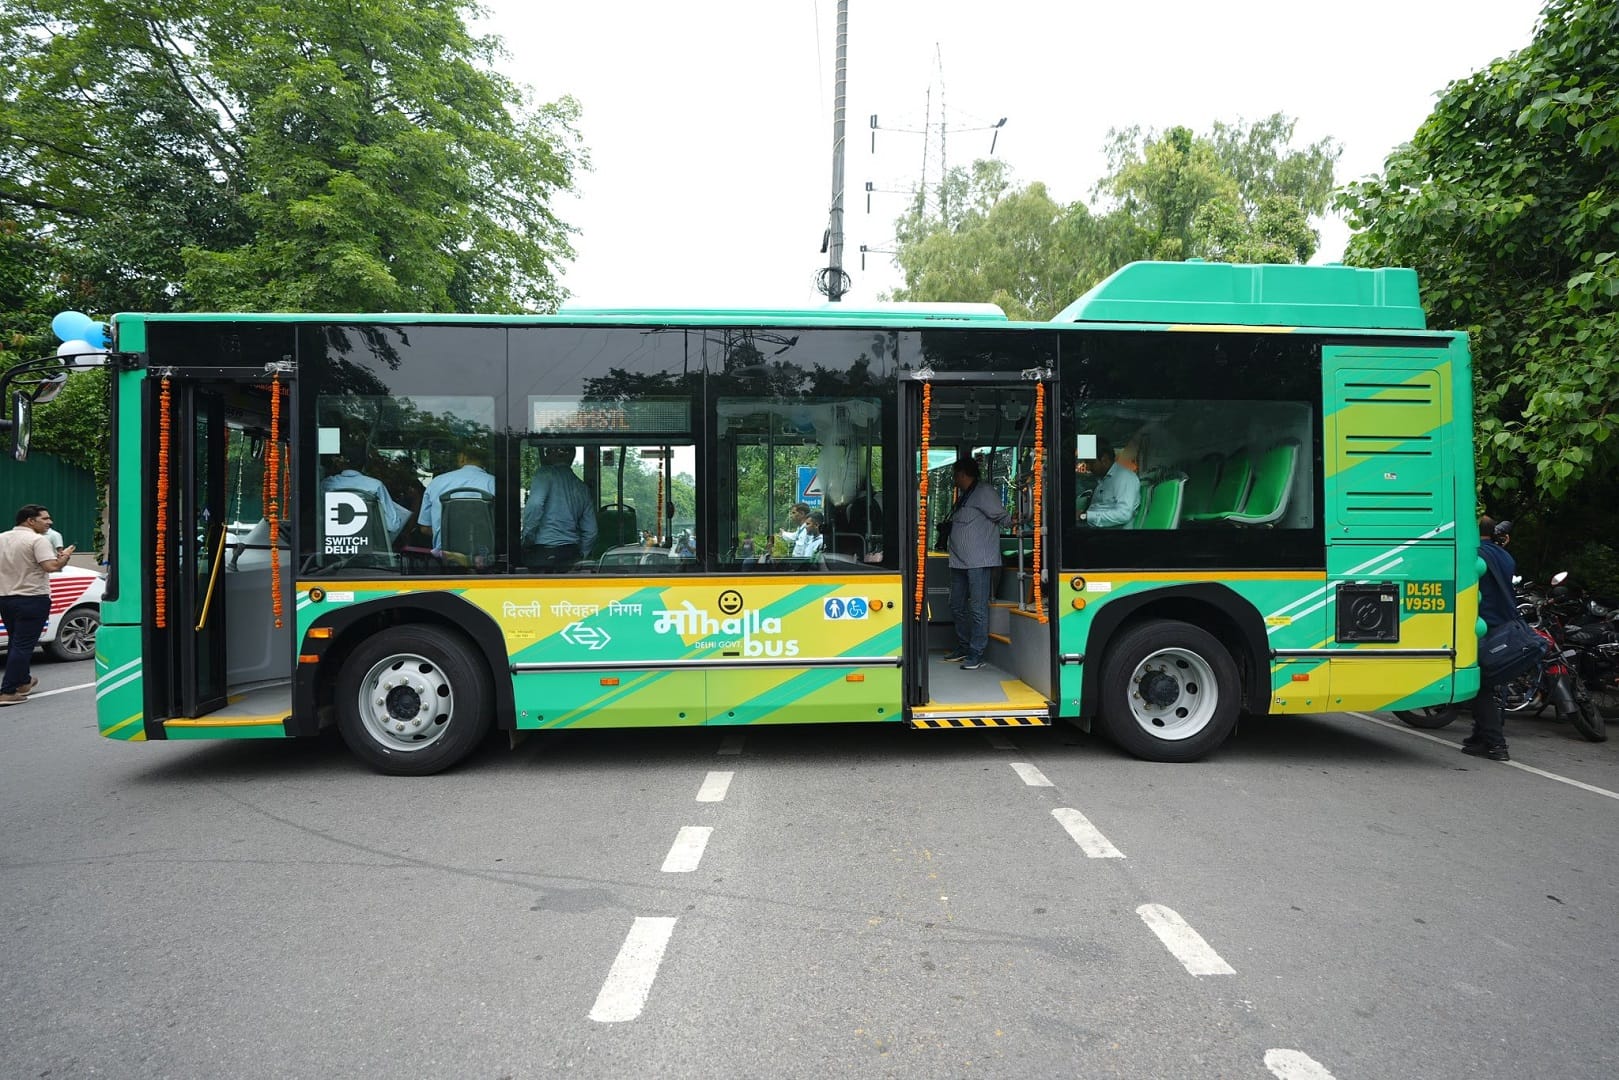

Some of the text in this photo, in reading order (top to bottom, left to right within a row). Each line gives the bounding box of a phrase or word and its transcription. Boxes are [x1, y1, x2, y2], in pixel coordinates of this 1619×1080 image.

[325, 536, 368, 546] SWITCH
[325, 545, 359, 555] DELHI
[1407, 582, 1442, 596] DL51E
[502, 600, 643, 618] दिल्ली परिवहन निगम
[1405, 597, 1446, 611] V9519
[695, 641, 717, 649] DELHI
[743, 632, 800, 657] bus
